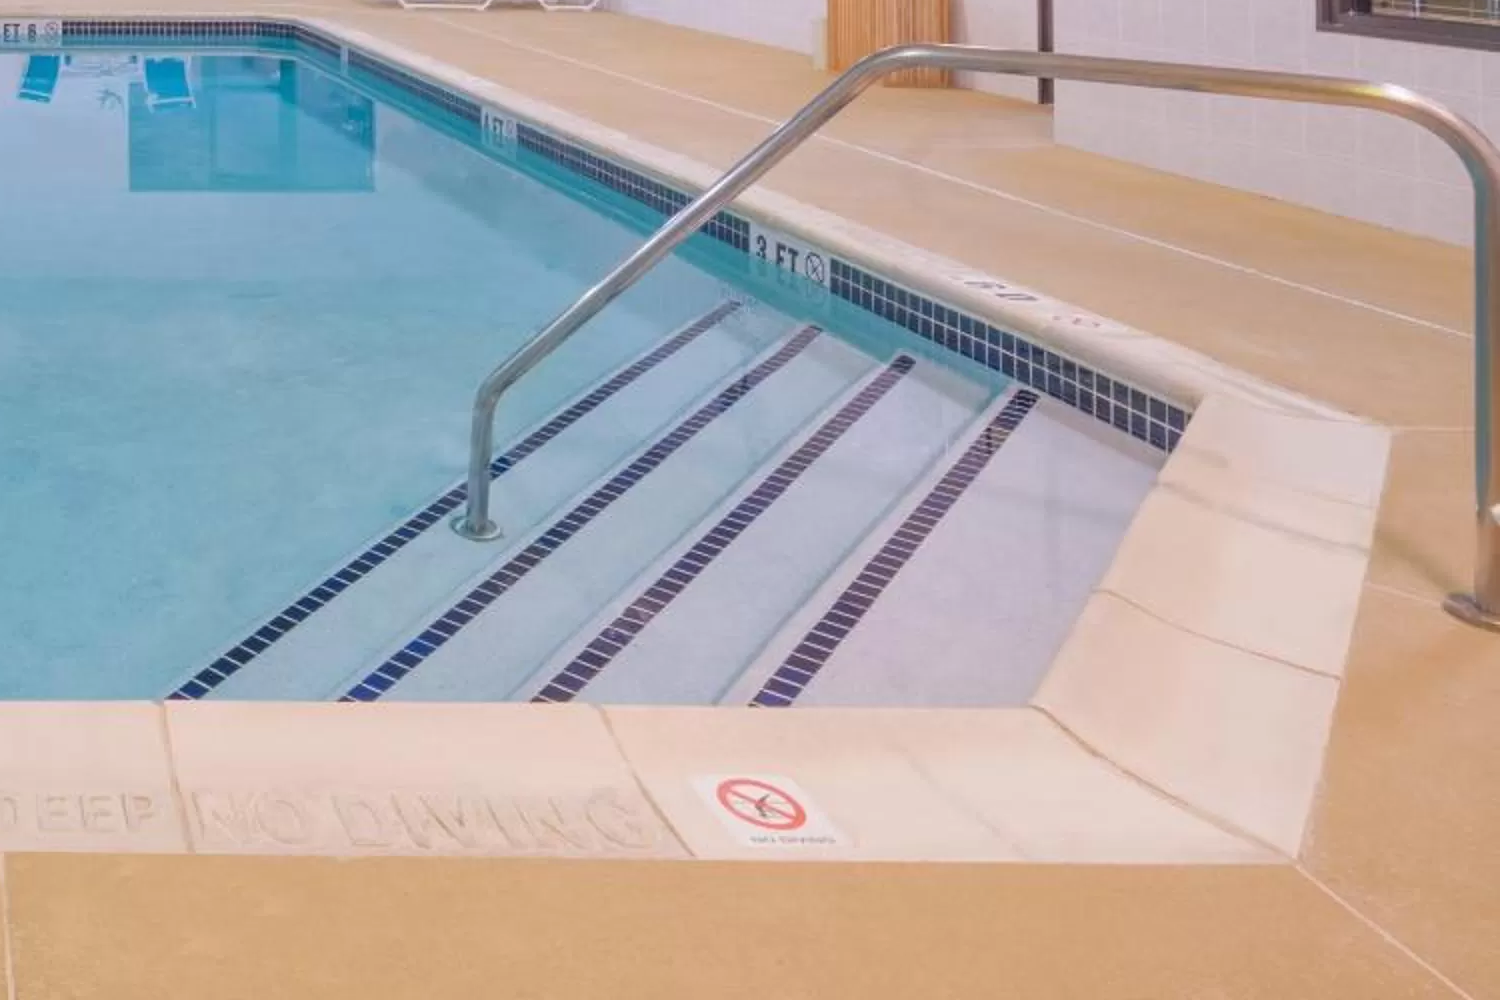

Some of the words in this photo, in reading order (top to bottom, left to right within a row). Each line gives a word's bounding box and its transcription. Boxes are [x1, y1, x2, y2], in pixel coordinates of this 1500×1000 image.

[755, 234, 767, 261] 3
[775, 241, 799, 273] FT
[192, 792, 314, 847] NO
[329, 790, 656, 850] DIVING
